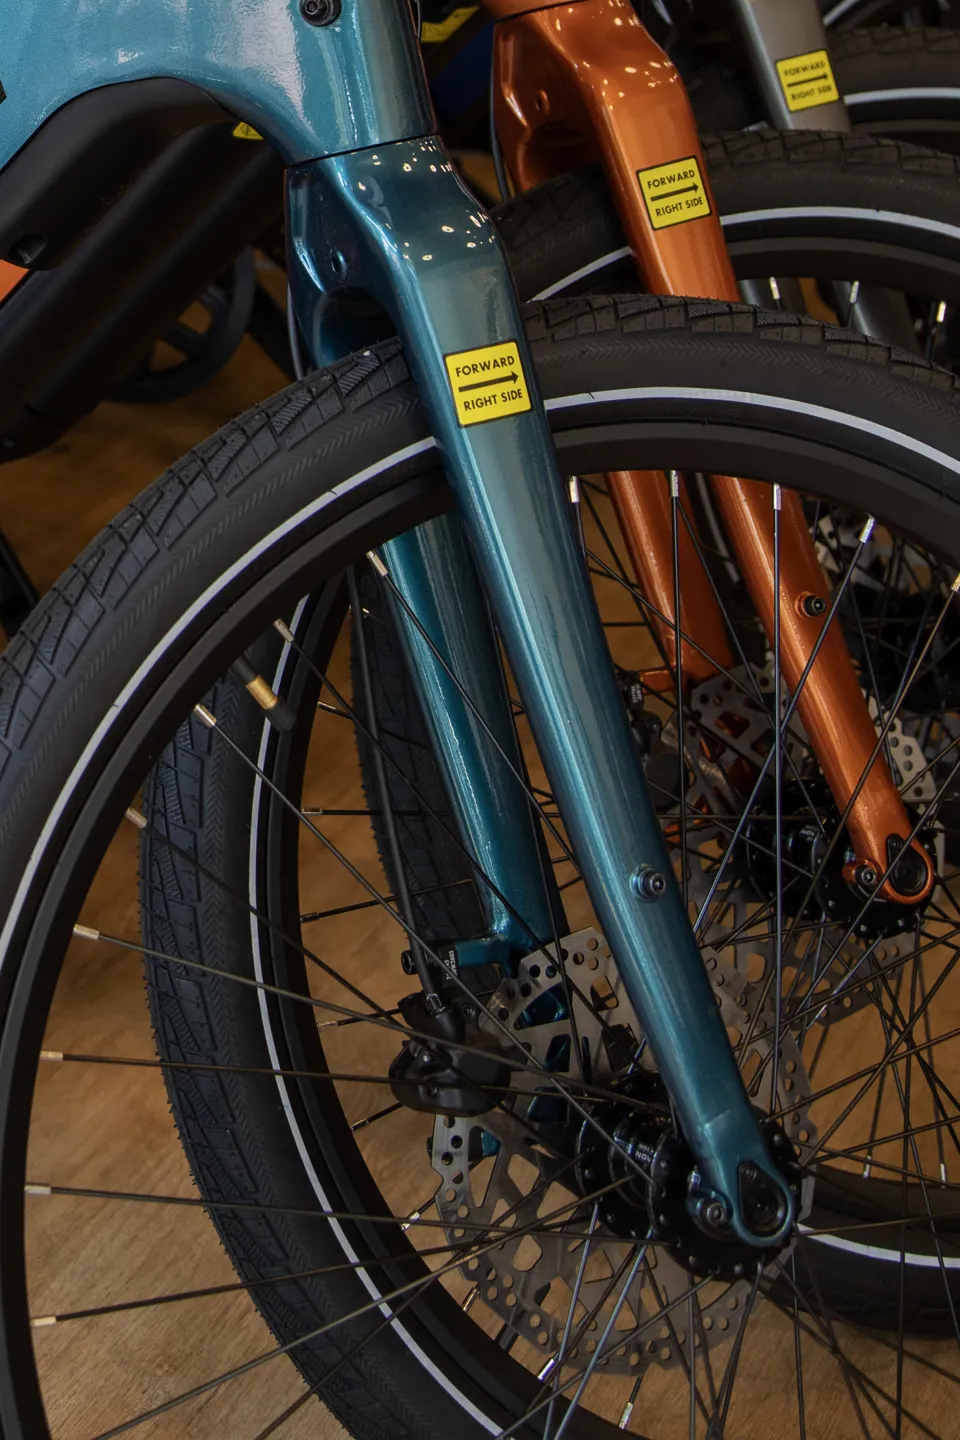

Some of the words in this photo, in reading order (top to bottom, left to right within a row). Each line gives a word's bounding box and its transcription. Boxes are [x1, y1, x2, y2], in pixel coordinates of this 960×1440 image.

[784, 61, 826, 77] FORWARD
[791, 89, 816, 101] RIGHT
[817, 84, 832, 95] SIDE
[647, 169, 696, 189] FORWARD
[655, 202, 683, 217] RIGHT
[685, 196, 703, 209] SIDE
[455, 356, 515, 377] FORWARD
[463, 394, 498, 411] RIGHT
[501, 389, 523, 403] SIDE
